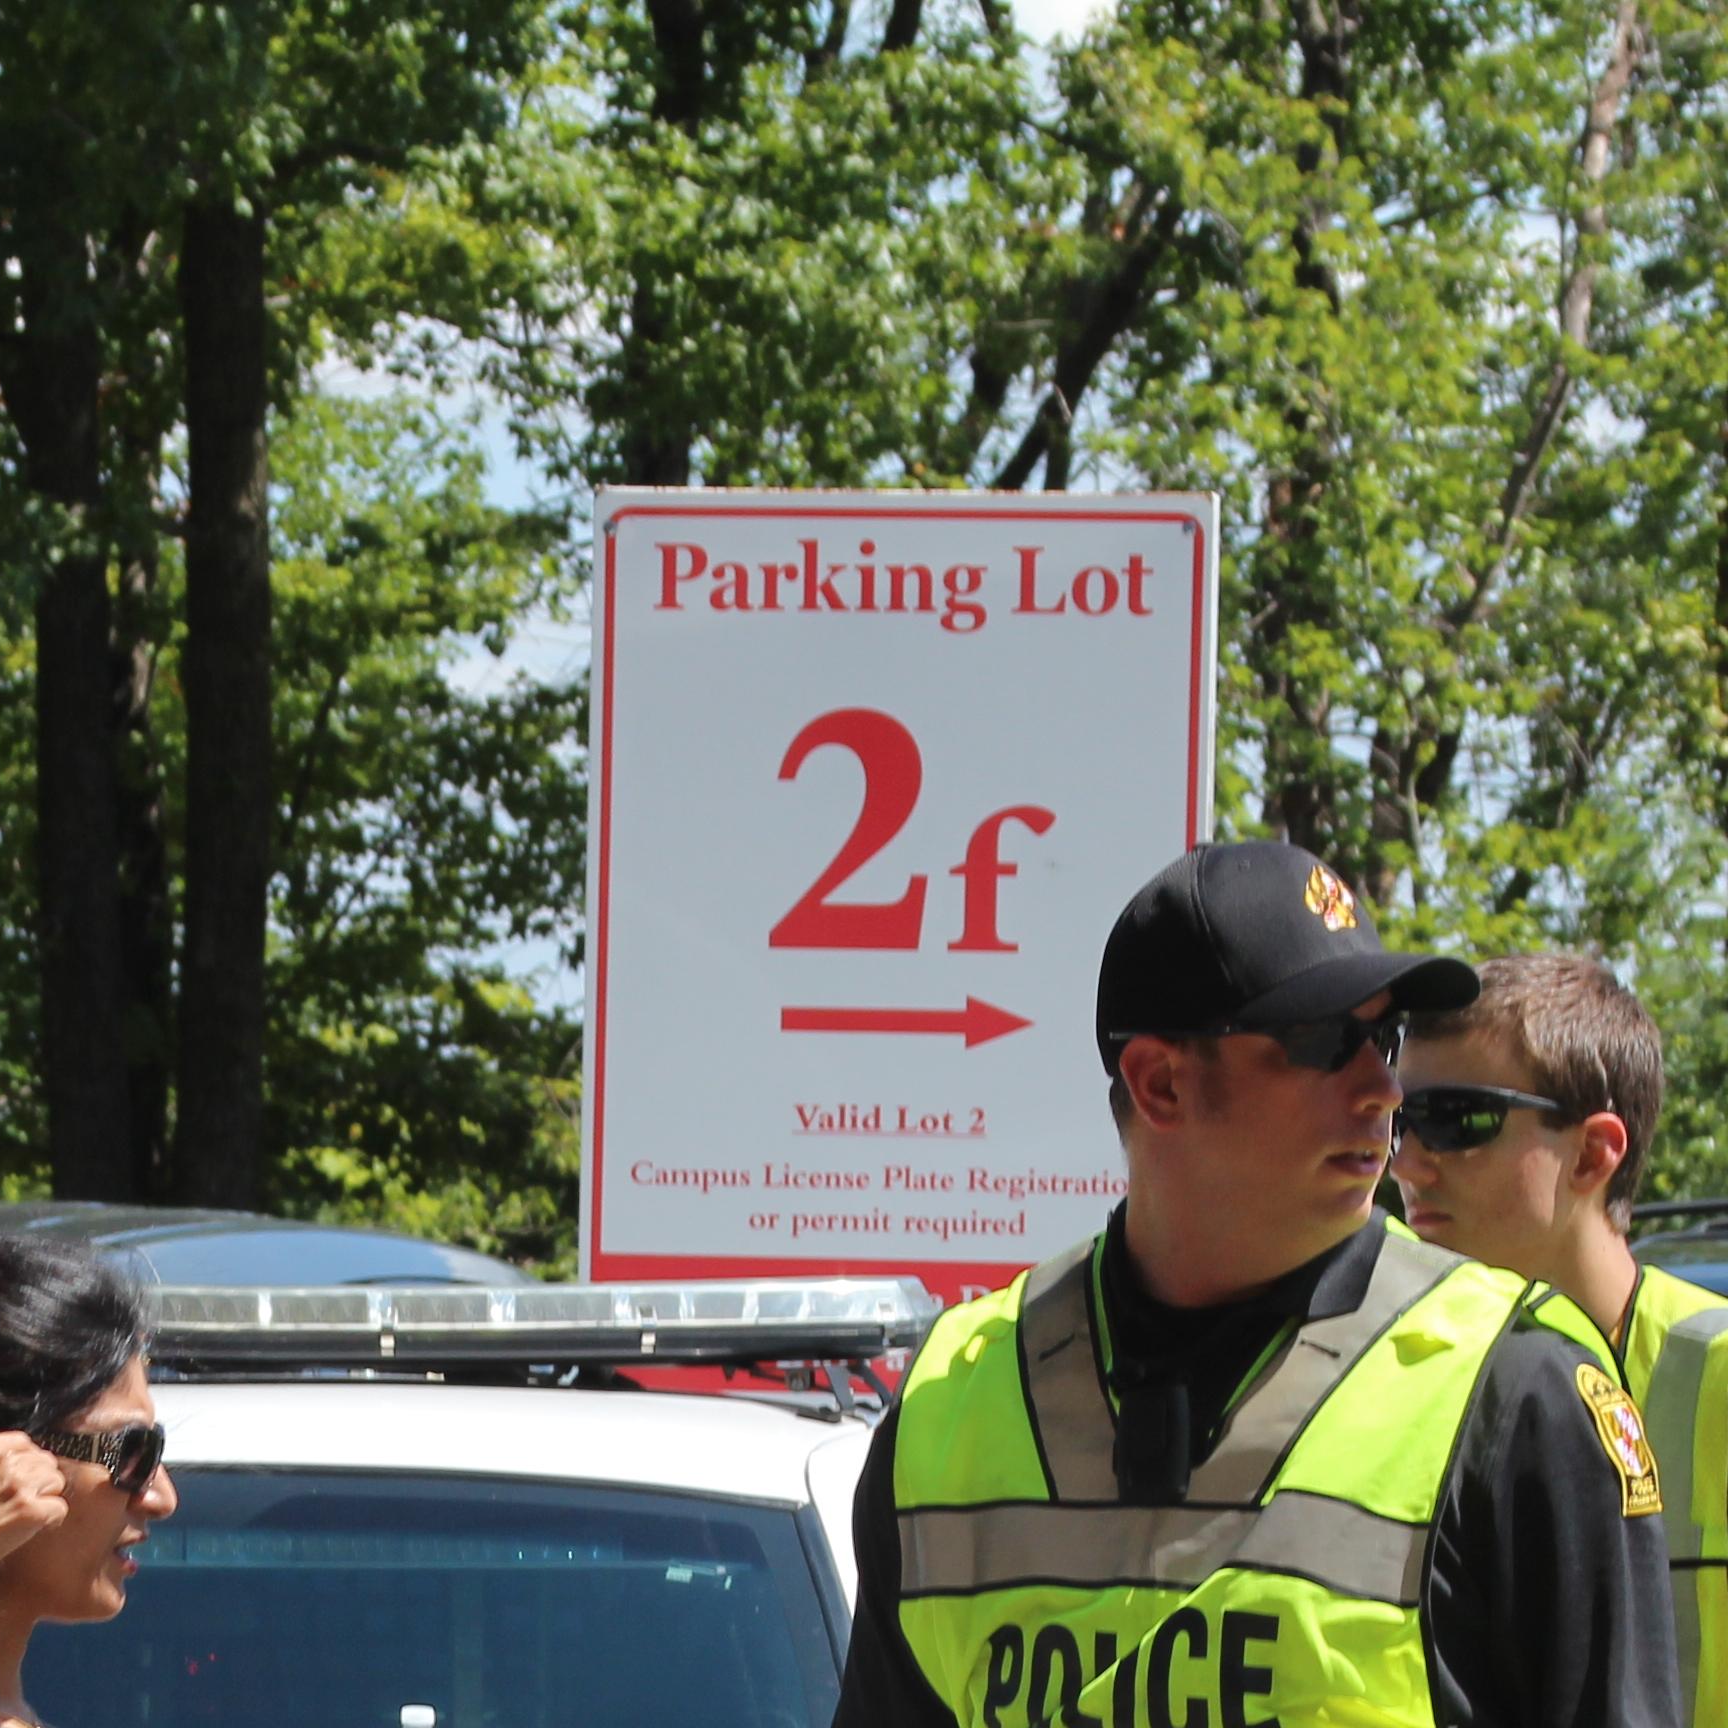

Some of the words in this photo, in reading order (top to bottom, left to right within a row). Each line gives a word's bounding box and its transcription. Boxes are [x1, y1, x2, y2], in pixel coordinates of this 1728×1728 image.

[654, 539, 988, 634] Parking
[1012, 545, 1154, 617] Lot
[768, 706, 1058, 953] 2f
[794, 1104, 882, 1133] Valid
[897, 1106, 953, 1134] Lot
[969, 1107, 986, 1134] 2
[631, 1162, 751, 1193] Campus
[764, 1163, 870, 1191] License
[883, 1166, 955, 1192] Plate
[968, 1169, 1129, 1198] Registratio
[749, 1212, 780, 1230] or
[792, 1208, 891, 1237] permit
[904, 1211, 1025, 1241] required
